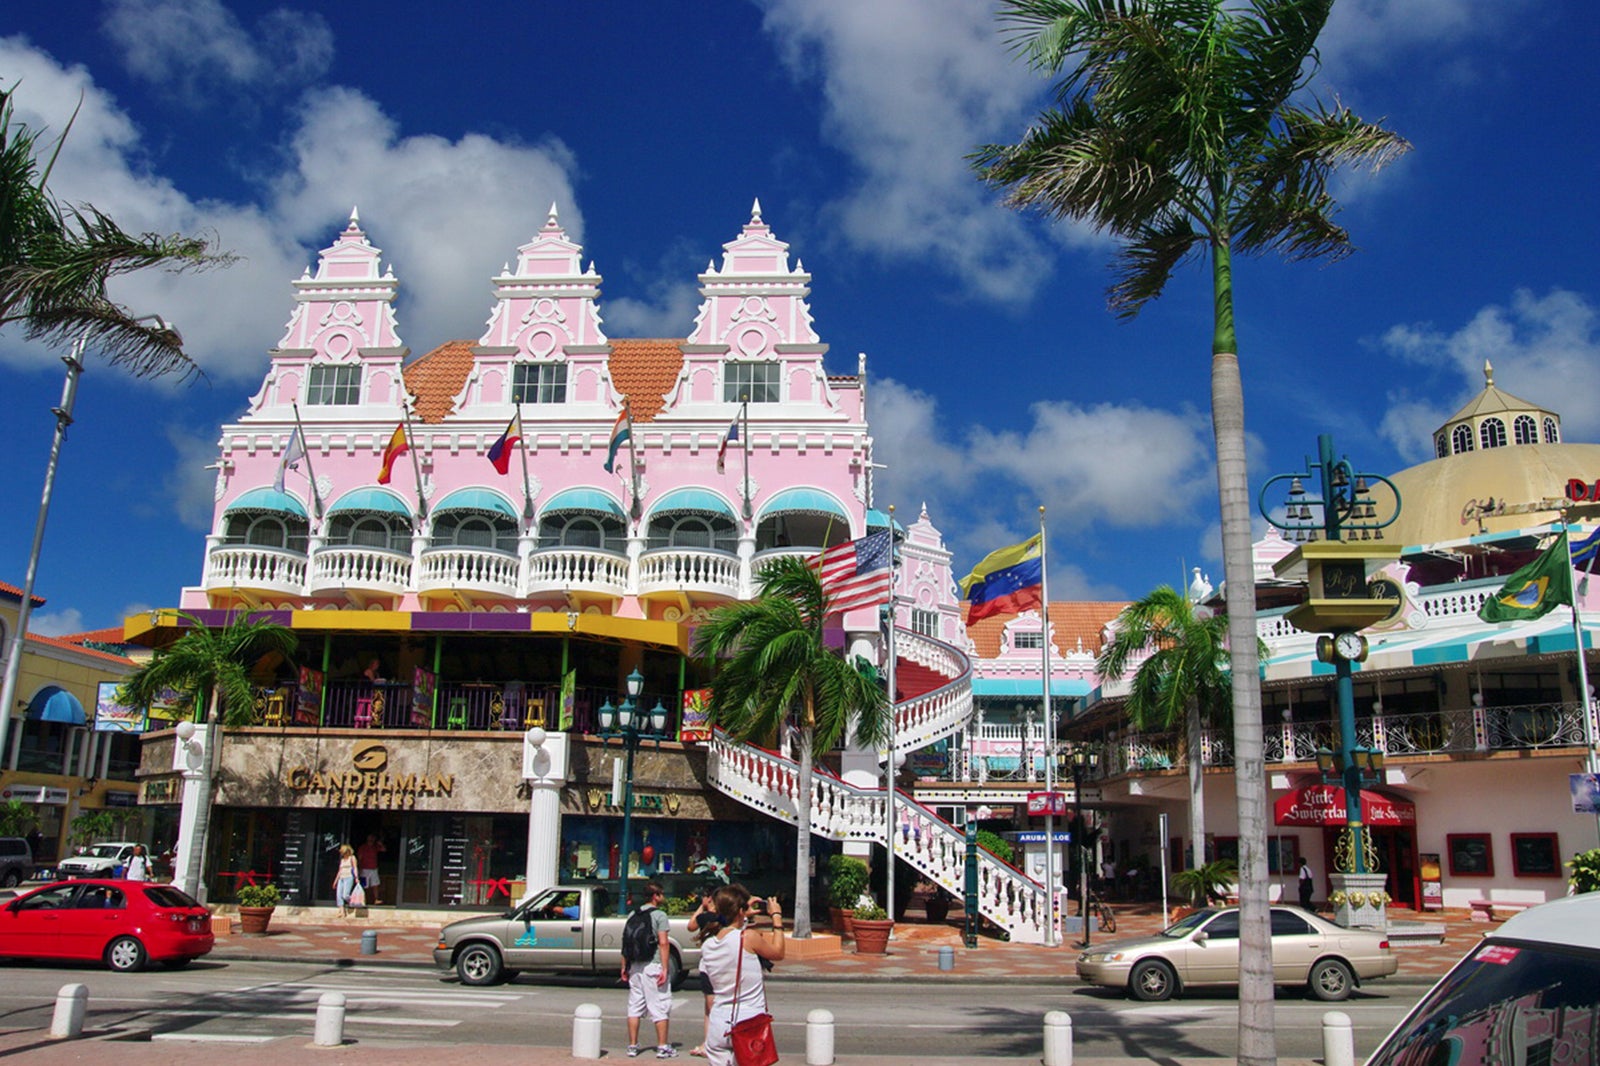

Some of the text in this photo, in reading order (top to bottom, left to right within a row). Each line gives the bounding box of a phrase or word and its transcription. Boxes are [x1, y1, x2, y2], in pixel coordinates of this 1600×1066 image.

[287, 765, 454, 793] GANDELMAN
[323, 791, 415, 807] JEWELERS
[606, 792, 663, 809] LEX
[1302, 789, 1334, 806] Little
[1282, 804, 1347, 823] Switzerla
